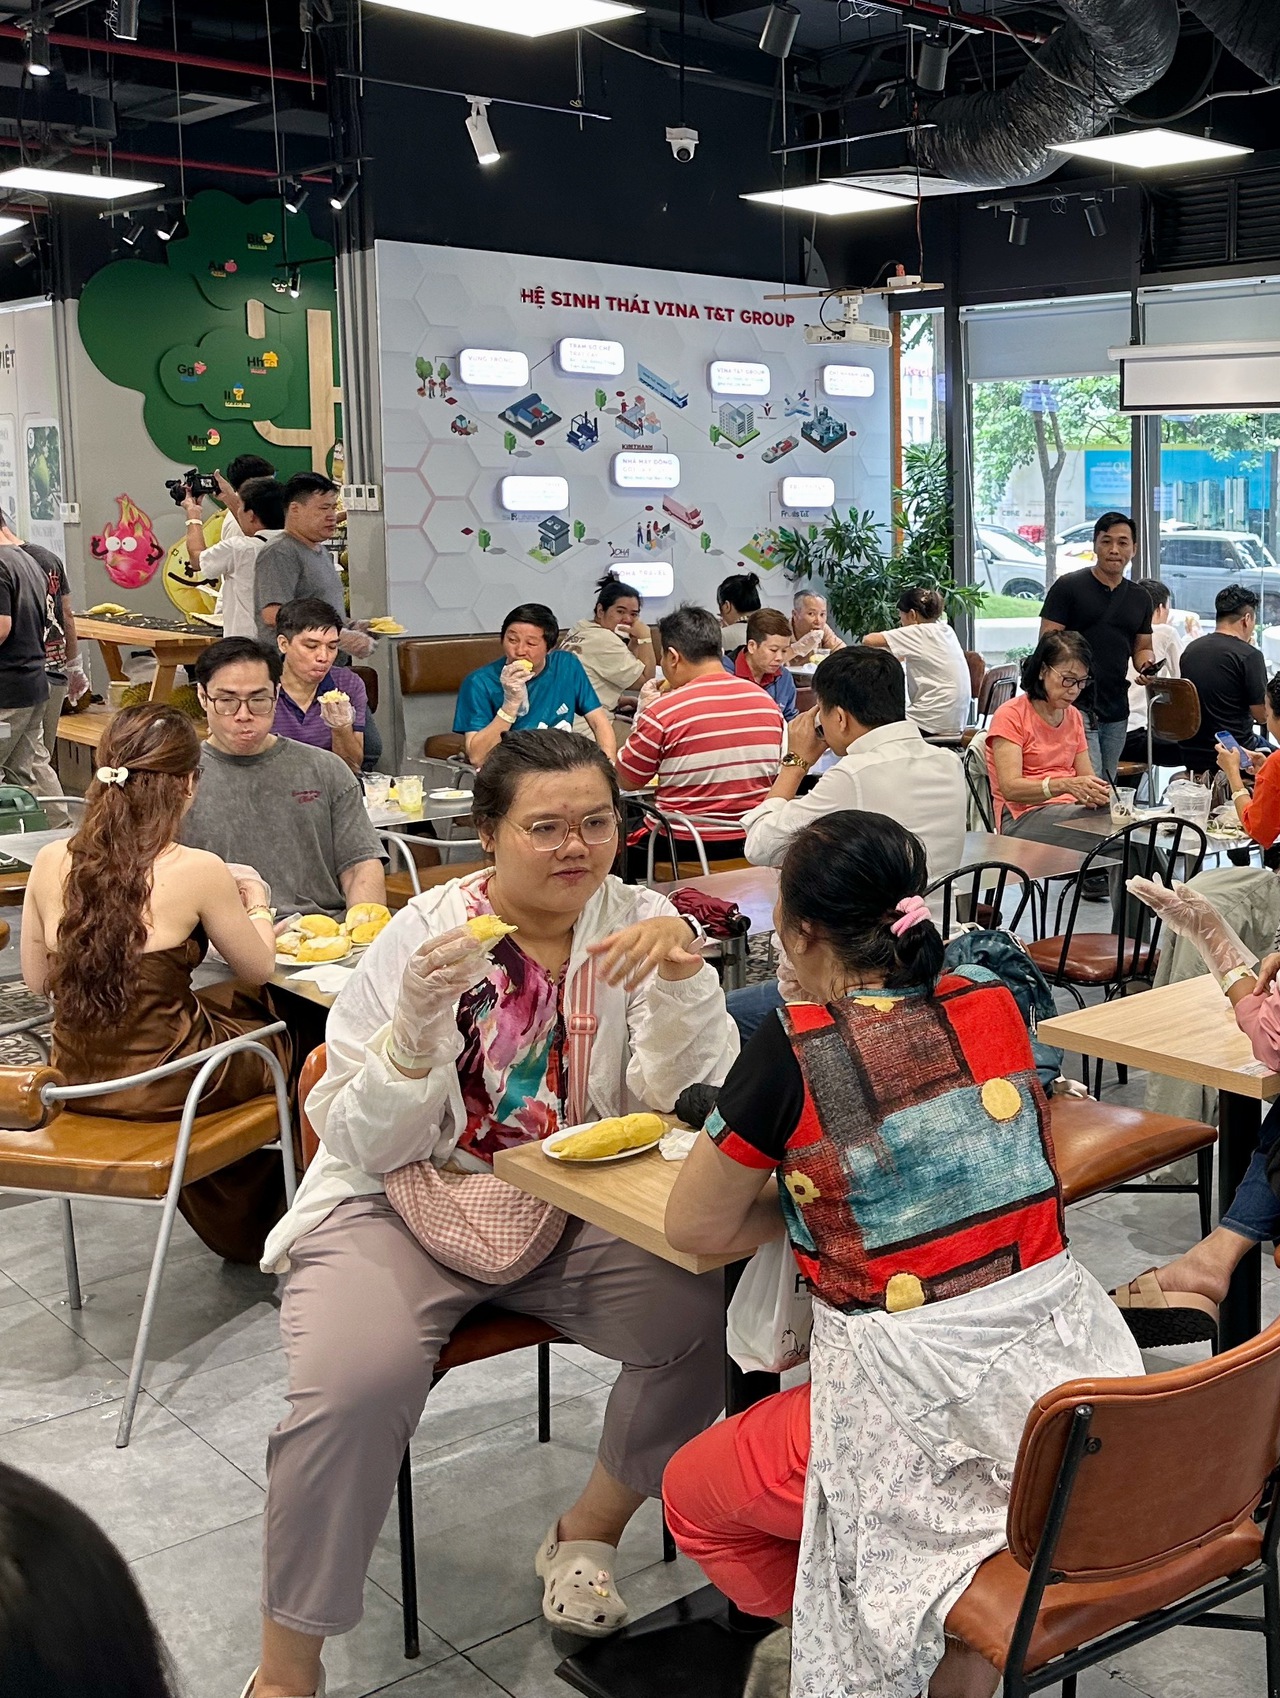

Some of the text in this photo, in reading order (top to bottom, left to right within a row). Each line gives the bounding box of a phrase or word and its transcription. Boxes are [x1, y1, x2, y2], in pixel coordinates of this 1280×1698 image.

[521, 285, 796, 328] HỆ SINH THÁI VINA T&T GROUP
[0, 343, 16, 375] IỆT
[177, 364, 195, 376] Gg
[247, 356, 264, 368] Hh
